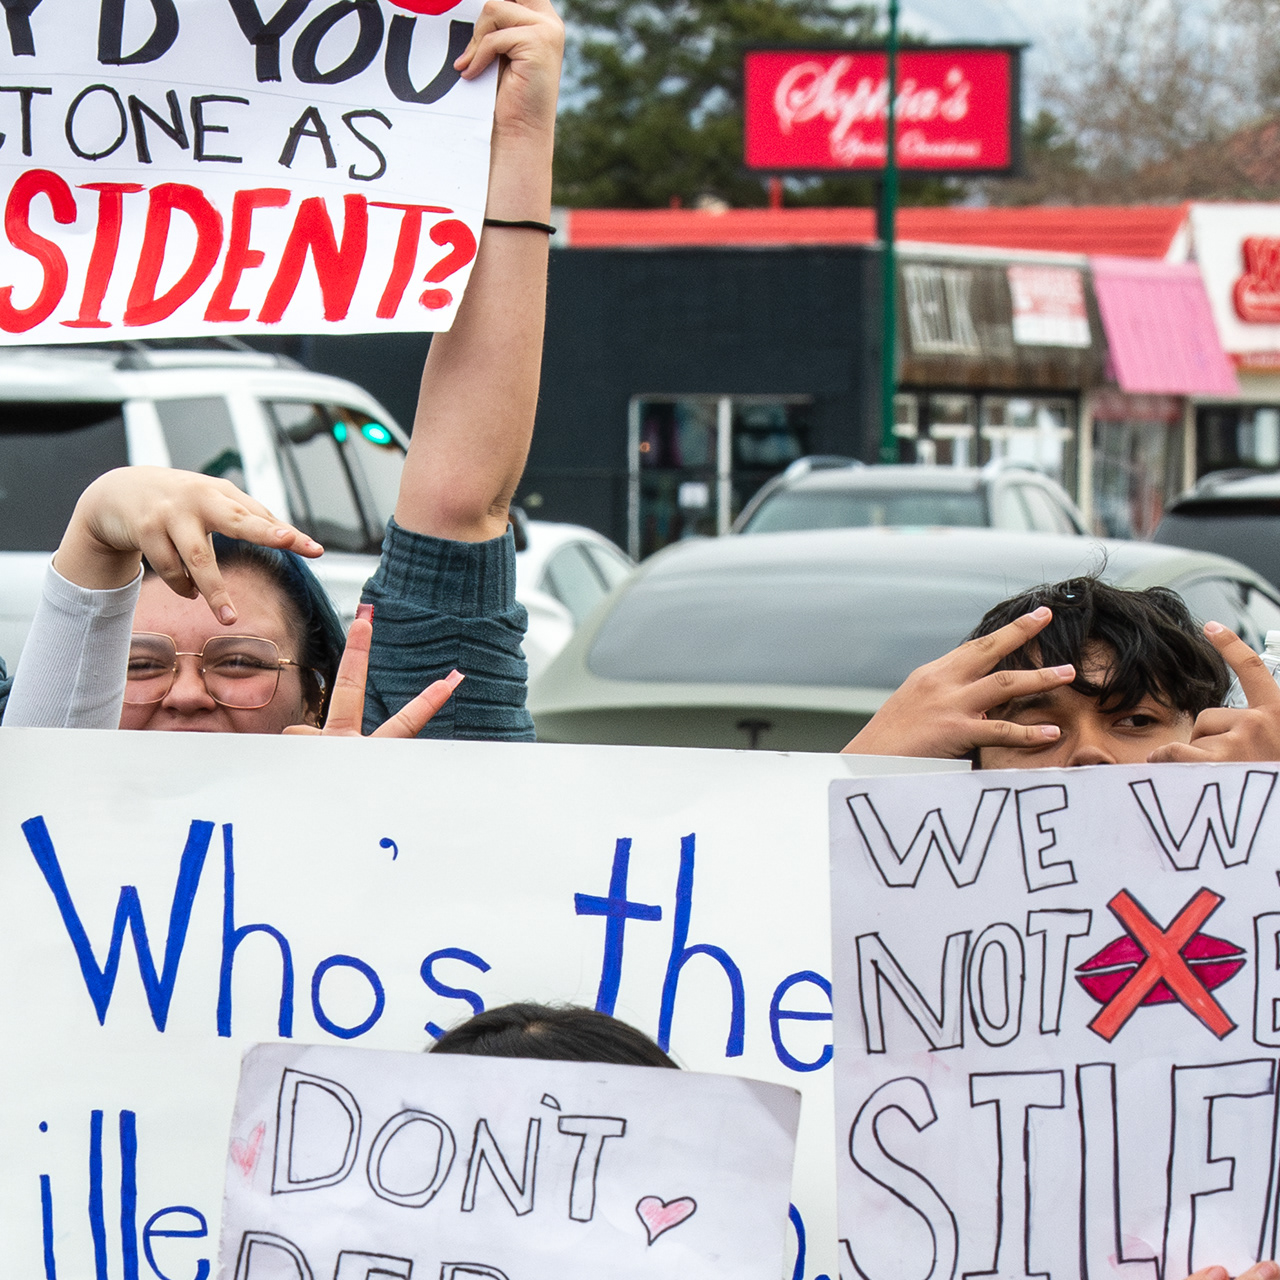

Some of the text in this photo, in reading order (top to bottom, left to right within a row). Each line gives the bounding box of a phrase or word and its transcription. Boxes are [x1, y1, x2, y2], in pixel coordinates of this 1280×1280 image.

[227, 0, 474, 104] YOU
[65, 84, 250, 165] ONE
[278, 106, 393, 181] AS
[846, 784, 1078, 893] WE
[20, 815, 834, 1072] Who's the
[854, 907, 1092, 1055] NOT
[271, 1067, 628, 1222] DON'T
